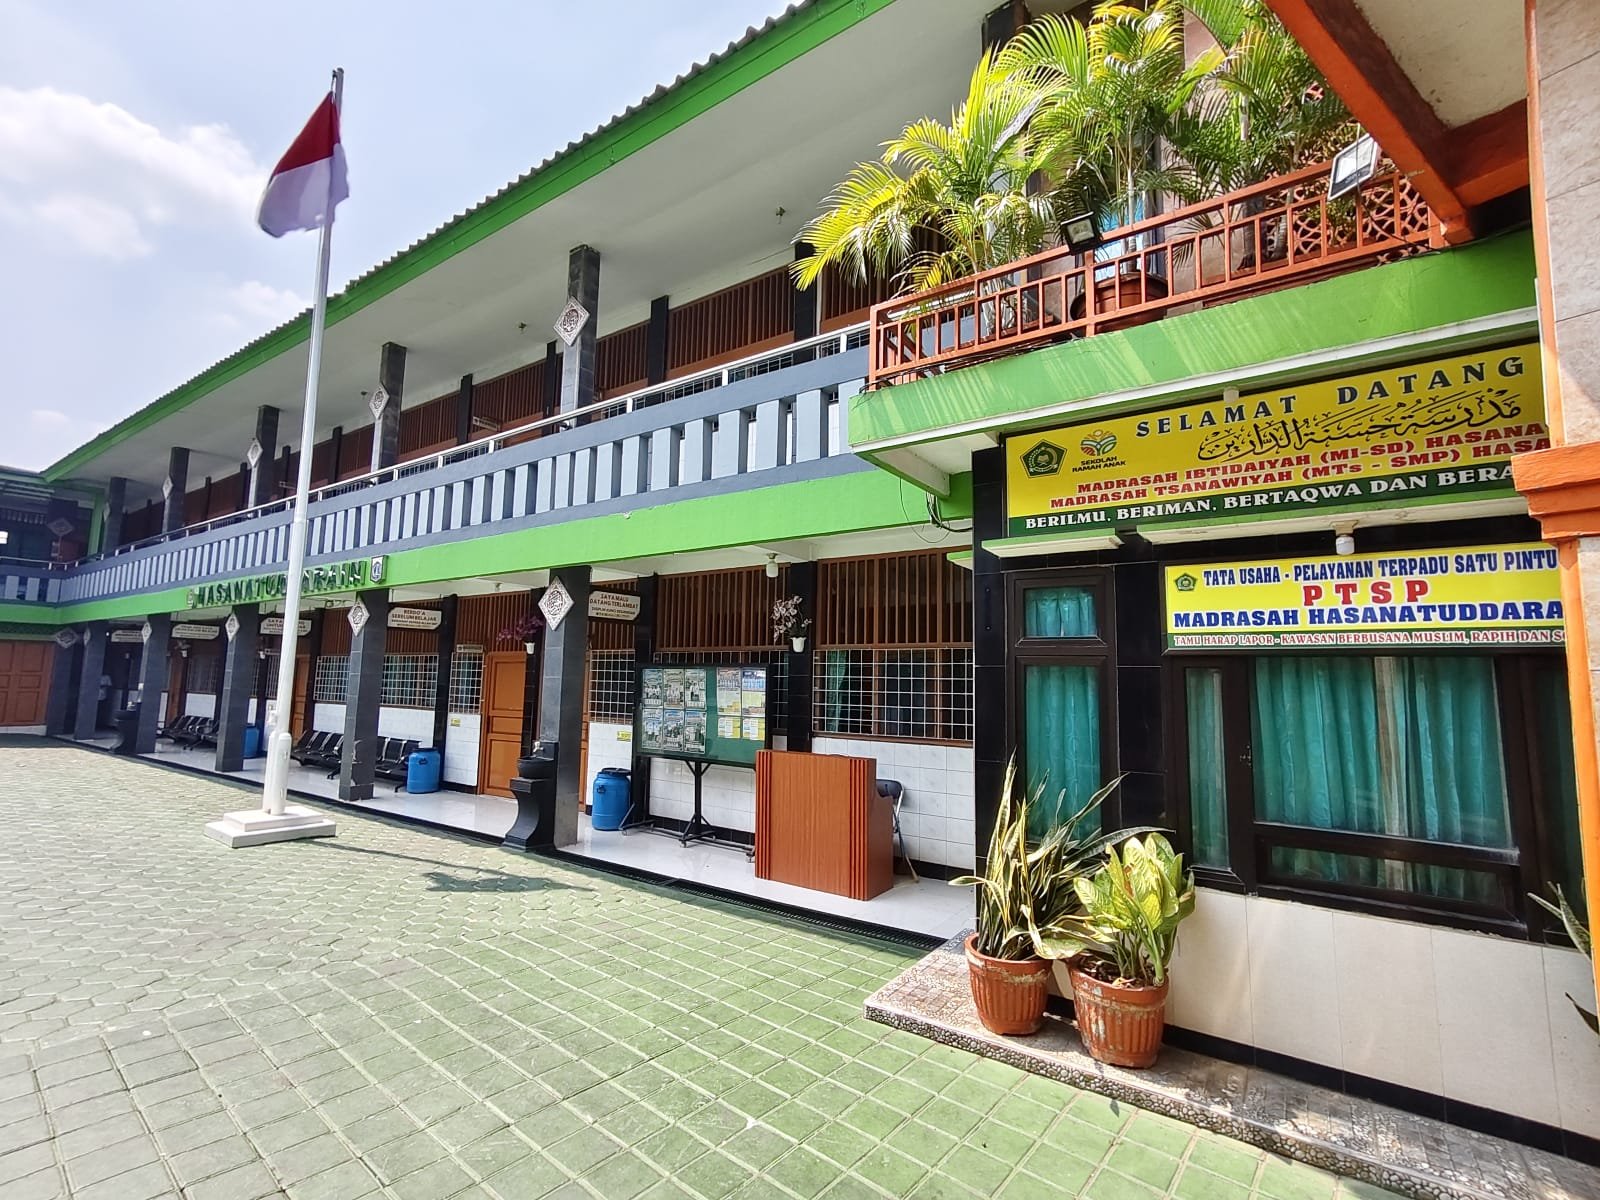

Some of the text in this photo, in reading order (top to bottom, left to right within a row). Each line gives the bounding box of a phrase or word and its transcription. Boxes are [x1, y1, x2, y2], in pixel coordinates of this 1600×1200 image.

[1136, 356, 1524, 438] SELAMAT DATANG
[1072, 460, 1126, 473] RAMAH ANAK
[1077, 422, 1545, 494] MADRASAH IBTIDAIYAH (MI-SD) HASANA
[1080, 455, 1118, 466] SEKOLAH
[1050, 488, 1148, 509] MADRASAH
[1154, 470, 1293, 497] TSANAWIYAH
[1302, 463, 1362, 479] (MTs
[1391, 450, 1461, 467] SMP)
[1223, 482, 1362, 509] BERTAQWA
[1370, 474, 1428, 493] DAN
[1203, 569, 1236, 586] TATA
[1239, 566, 1281, 585] USAHA
[1293, 560, 1374, 582] PELAYANAN
[1377, 555, 1449, 577] TERPADU
[1454, 551, 1498, 574] SATU
[1504, 548, 1558, 571] PINTU
[1173, 600, 1564, 628] MADRASAH HASANATUDDARA
[1174, 636, 1201, 646] TAMU
[1203, 635, 1237, 645] HARAP
[1240, 634, 1274, 645] LAPOR
[1282, 633, 1335, 645] KAWASAN
[1338, 632, 1410, 644] BERBUSANA
[1413, 630, 1470, 644] MUSLIM,
[1472, 630, 1516, 642] RAPIH
[1520, 630, 1549, 642] DAN
